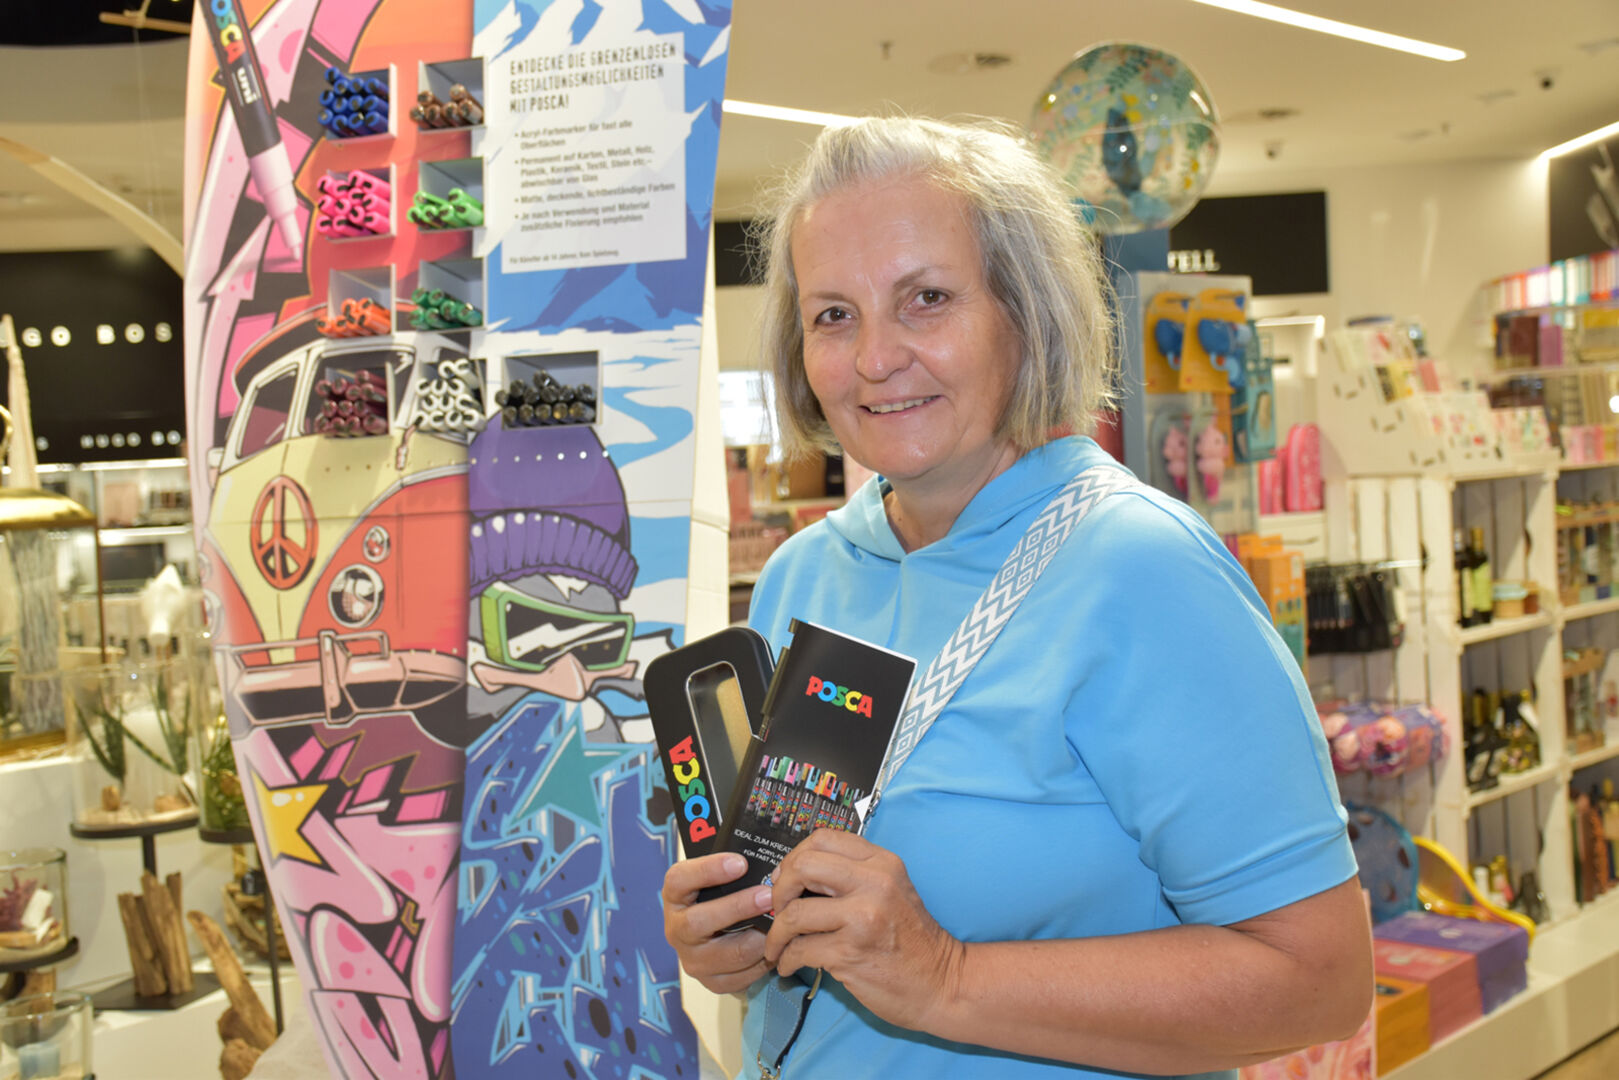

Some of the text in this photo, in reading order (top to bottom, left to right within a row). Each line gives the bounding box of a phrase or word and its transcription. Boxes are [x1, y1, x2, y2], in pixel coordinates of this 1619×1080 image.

[211, 0, 246, 64] OSCA
[510, 42, 676, 75] ENTDECKE DIE GRENZENLOSEN
[237, 67, 258, 104] uni
[510, 64, 664, 94] GESTALTUNGSMÖGLICHKEITEN
[510, 94, 569, 112] MIT POSCA!
[520, 120, 632, 139] Acryl-Farbmarker für fast alle
[520, 139, 565, 150] Oberflächen
[520, 155, 561, 166] Permanent
[564, 153, 576, 162] auf
[611, 158, 630, 168] Stein
[582, 174, 598, 183] Glas
[587, 184, 646, 198] lichtbeständige
[649, 182, 675, 192] Farben
[520, 201, 650, 220] Je nach Verwendung und Material
[520, 214, 643, 232] zusätzliche Fixierung empfohlen
[1167, 250, 1221, 273] TELL
[96, 321, 173, 345] BOS
[151, 430, 182, 446] BO
[806, 676, 872, 718] POSCA
[668, 735, 717, 843] POSCA
[734, 828, 793, 854] IDEAL ZUM KREAT
[756, 852, 770, 862] FAST
[758, 848, 784, 860] ACRYL-FA
